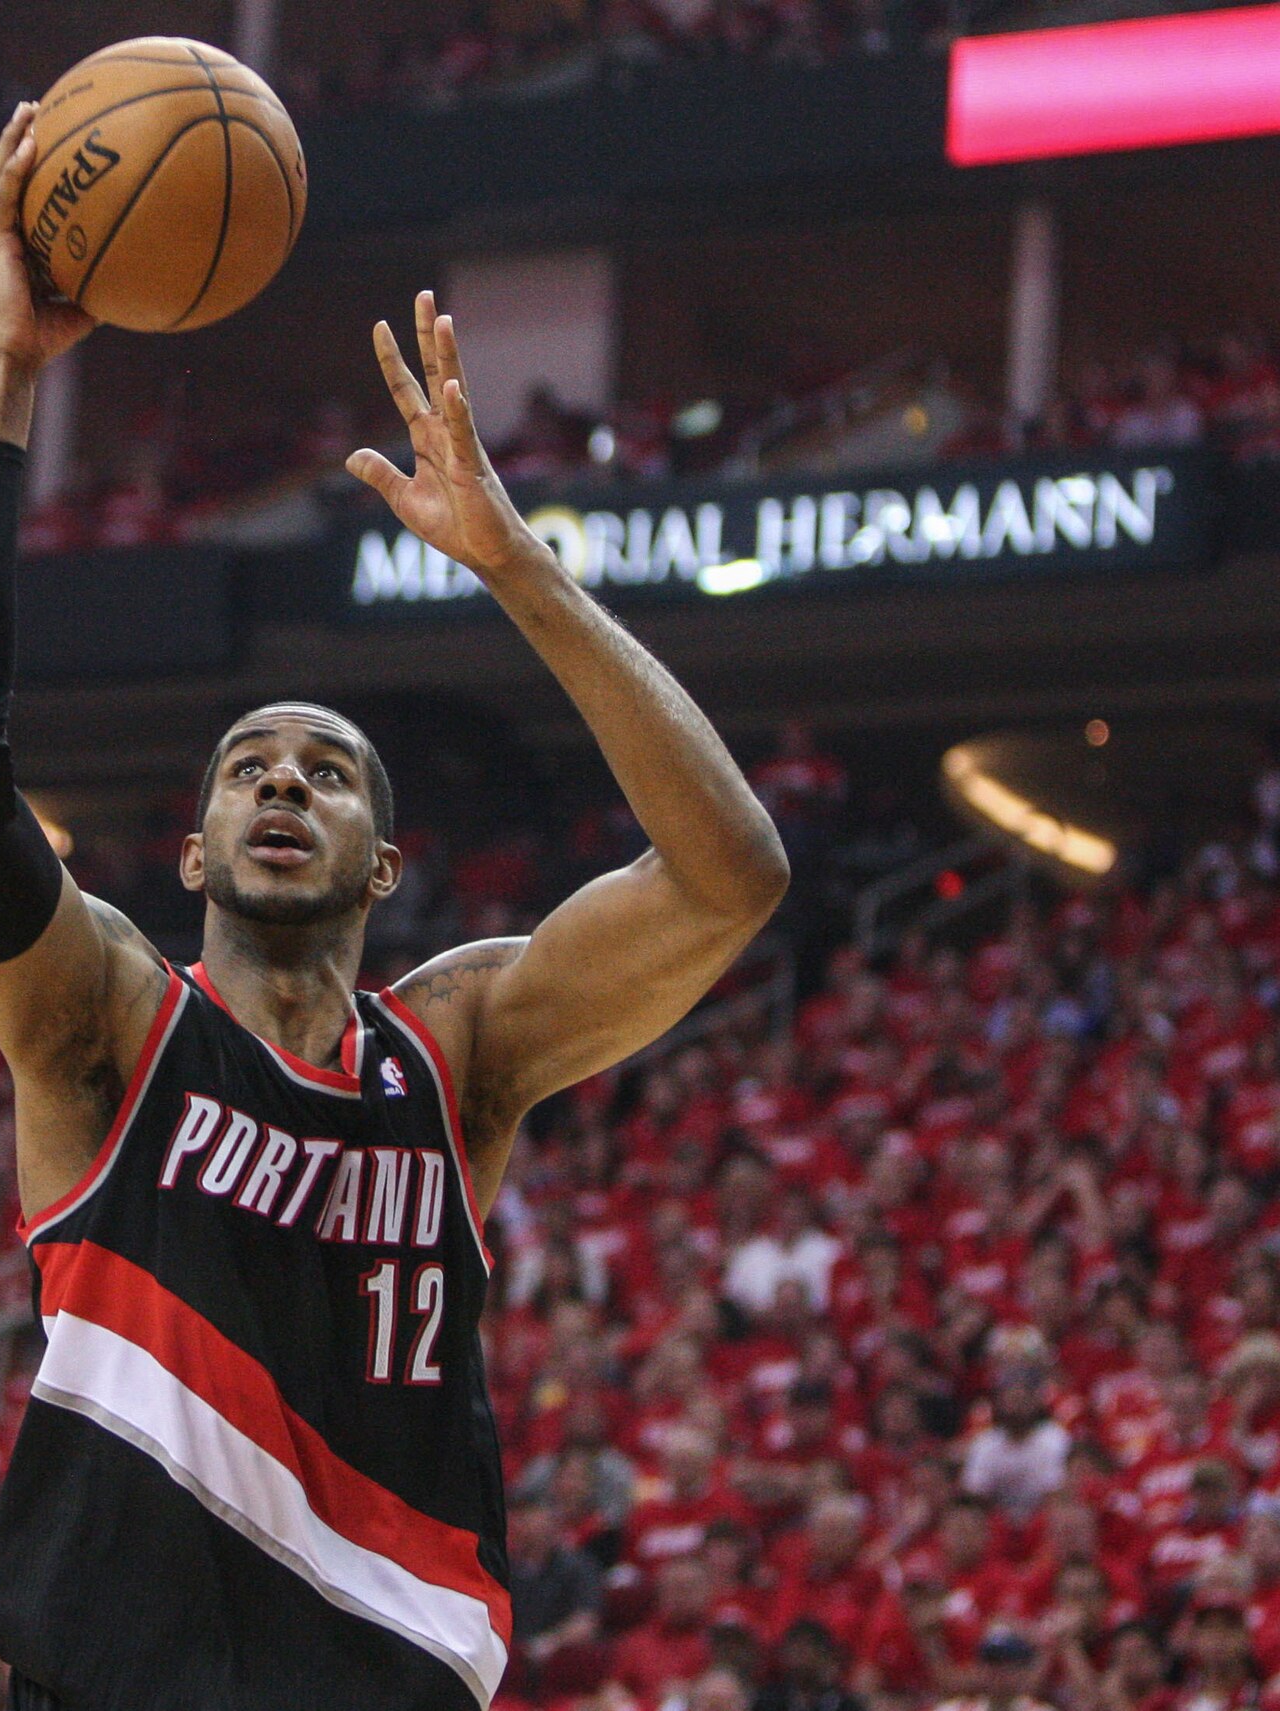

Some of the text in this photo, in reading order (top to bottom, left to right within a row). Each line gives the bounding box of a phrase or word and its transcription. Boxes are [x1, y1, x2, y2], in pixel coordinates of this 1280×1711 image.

[28, 126, 120, 264] SPALDI
[354, 503, 722, 602] MEORIAL
[157, 1091, 445, 1248] PORTAND
[358, 1258, 445, 1386] 12
